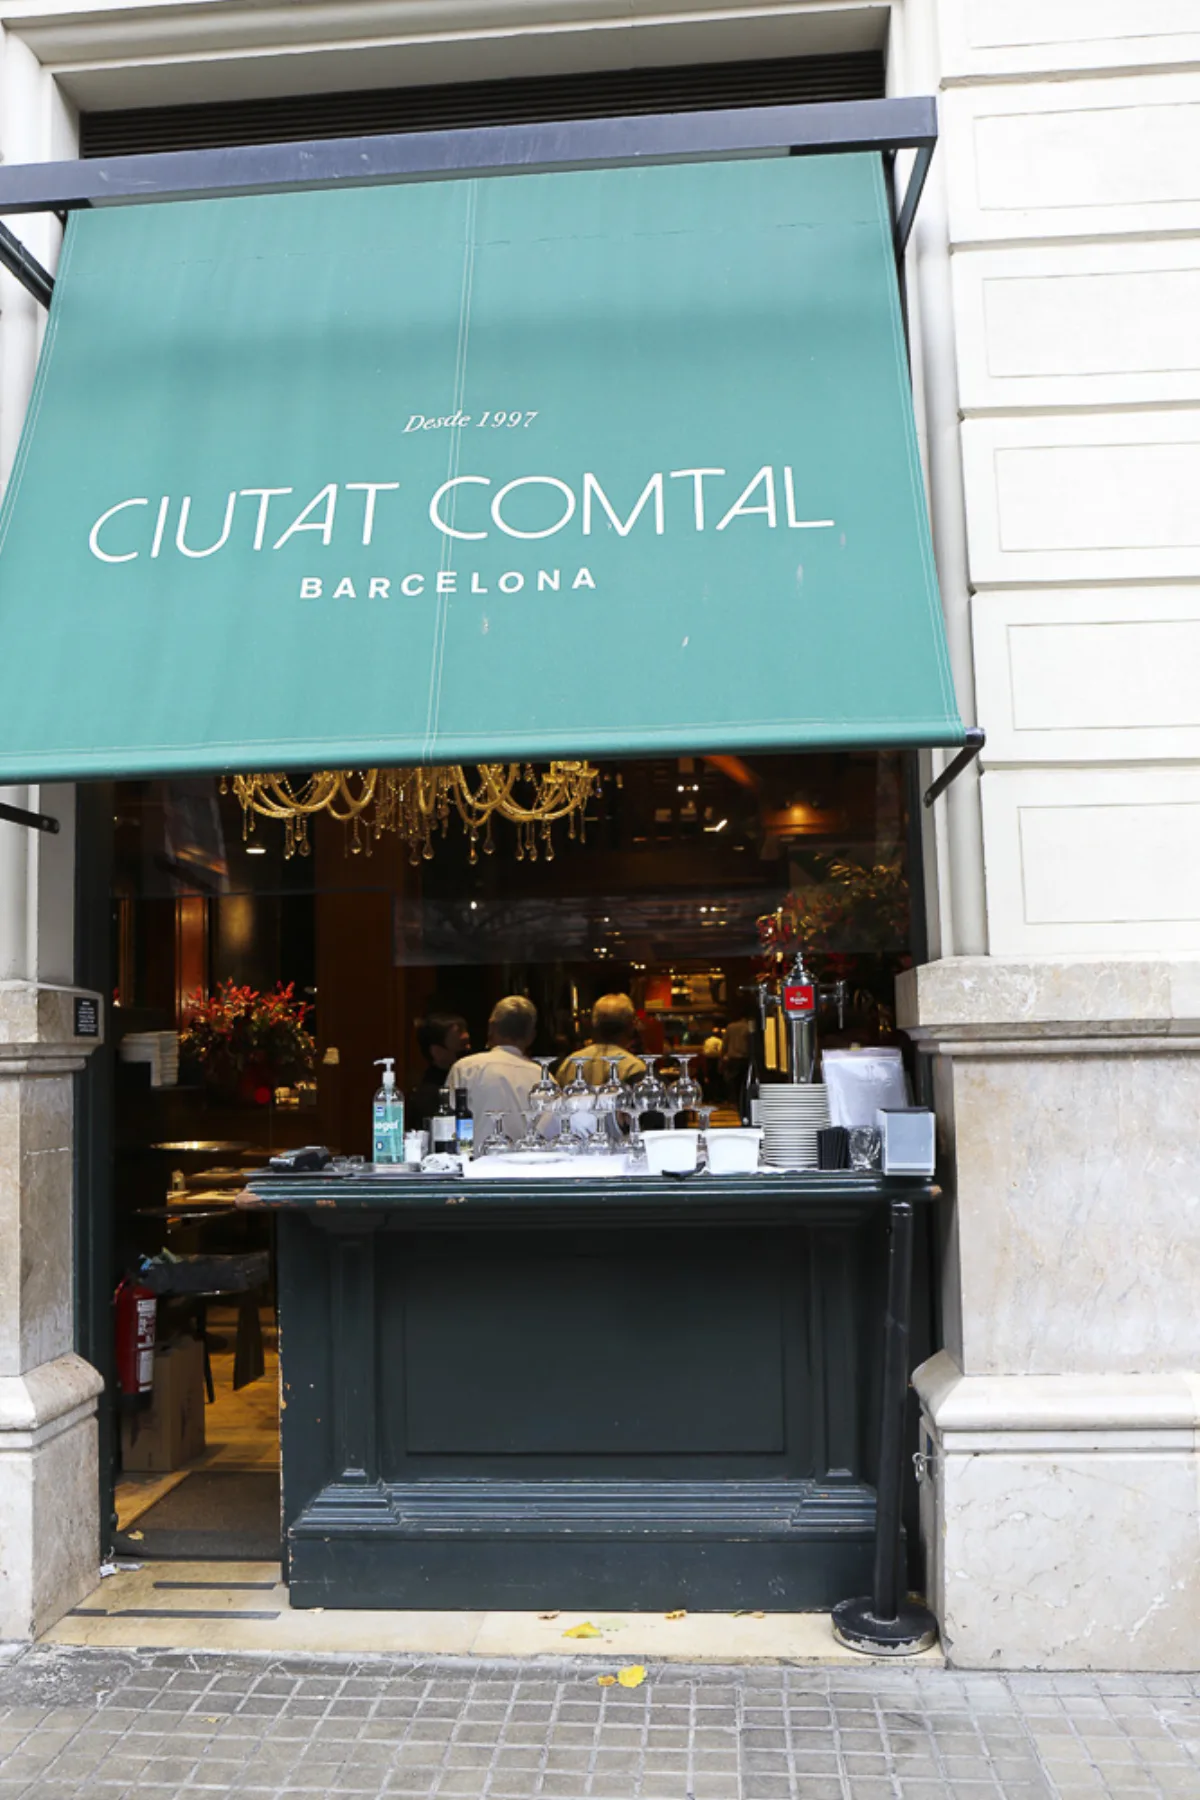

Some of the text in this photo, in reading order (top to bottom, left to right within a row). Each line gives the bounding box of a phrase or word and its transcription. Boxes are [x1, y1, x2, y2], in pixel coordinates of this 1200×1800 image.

[402, 409, 538, 433] Desde 1997
[89, 465, 835, 562] CIUTAT COMTAL
[299, 567, 596, 600] BARCELONA
